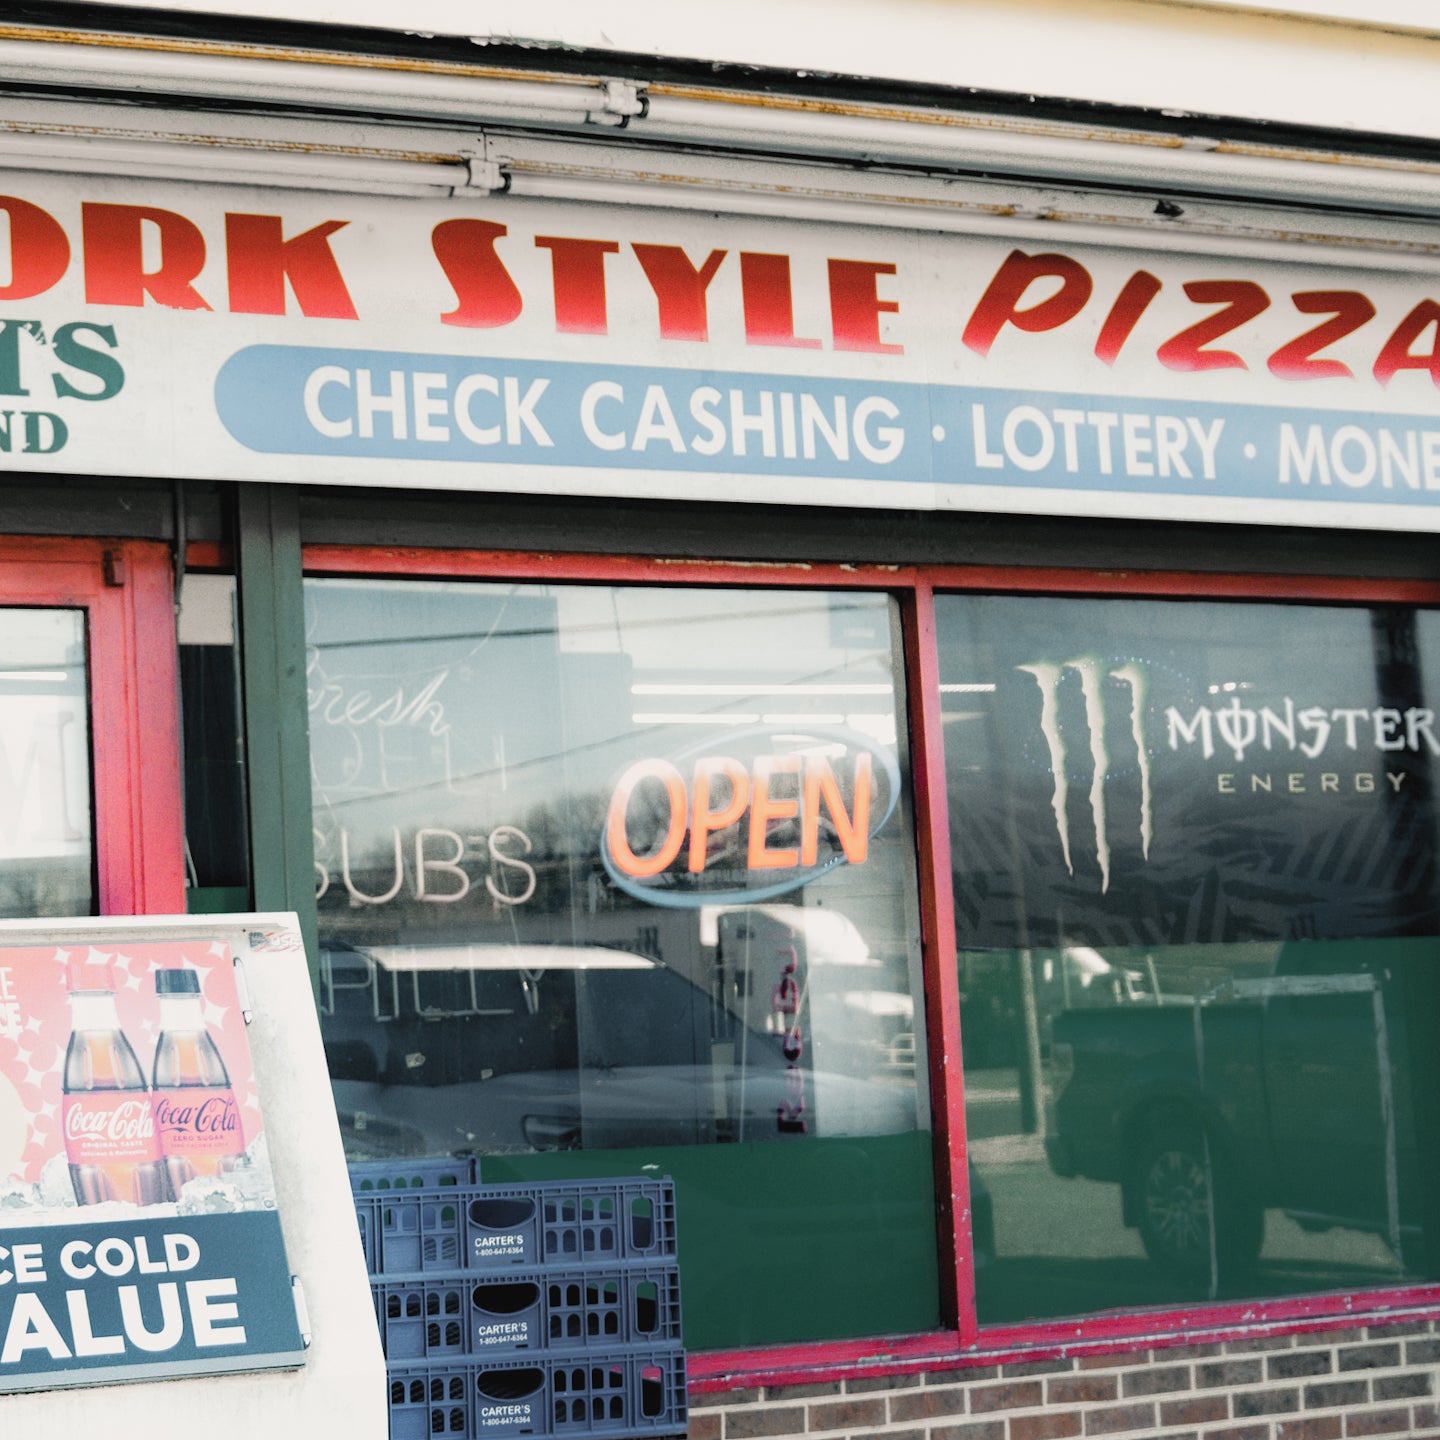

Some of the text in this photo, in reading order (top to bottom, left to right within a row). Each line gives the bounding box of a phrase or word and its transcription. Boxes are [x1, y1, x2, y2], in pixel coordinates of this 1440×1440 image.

[430, 218, 904, 355] STYLE
[961, 249, 1440, 390] PIZZA
[304, 366, 555, 447] CHECK
[580, 380, 904, 464] CASHING
[972, 403, 1226, 480] LOTTERY
[1165, 697, 1440, 761] MONSTER
[1217, 773, 1406, 794] ENERGY
[607, 751, 873, 878] OPEN
[66, 1100, 155, 1141] Coca-Cola
[156, 1097, 236, 1133] Coca-Cola
[59, 1233, 201, 1280] COLD
[474, 1235, 524, 1247] CARTER'S
[478, 1322, 528, 1336] CARTER'S
[481, 1404, 531, 1417] CARTER'S
